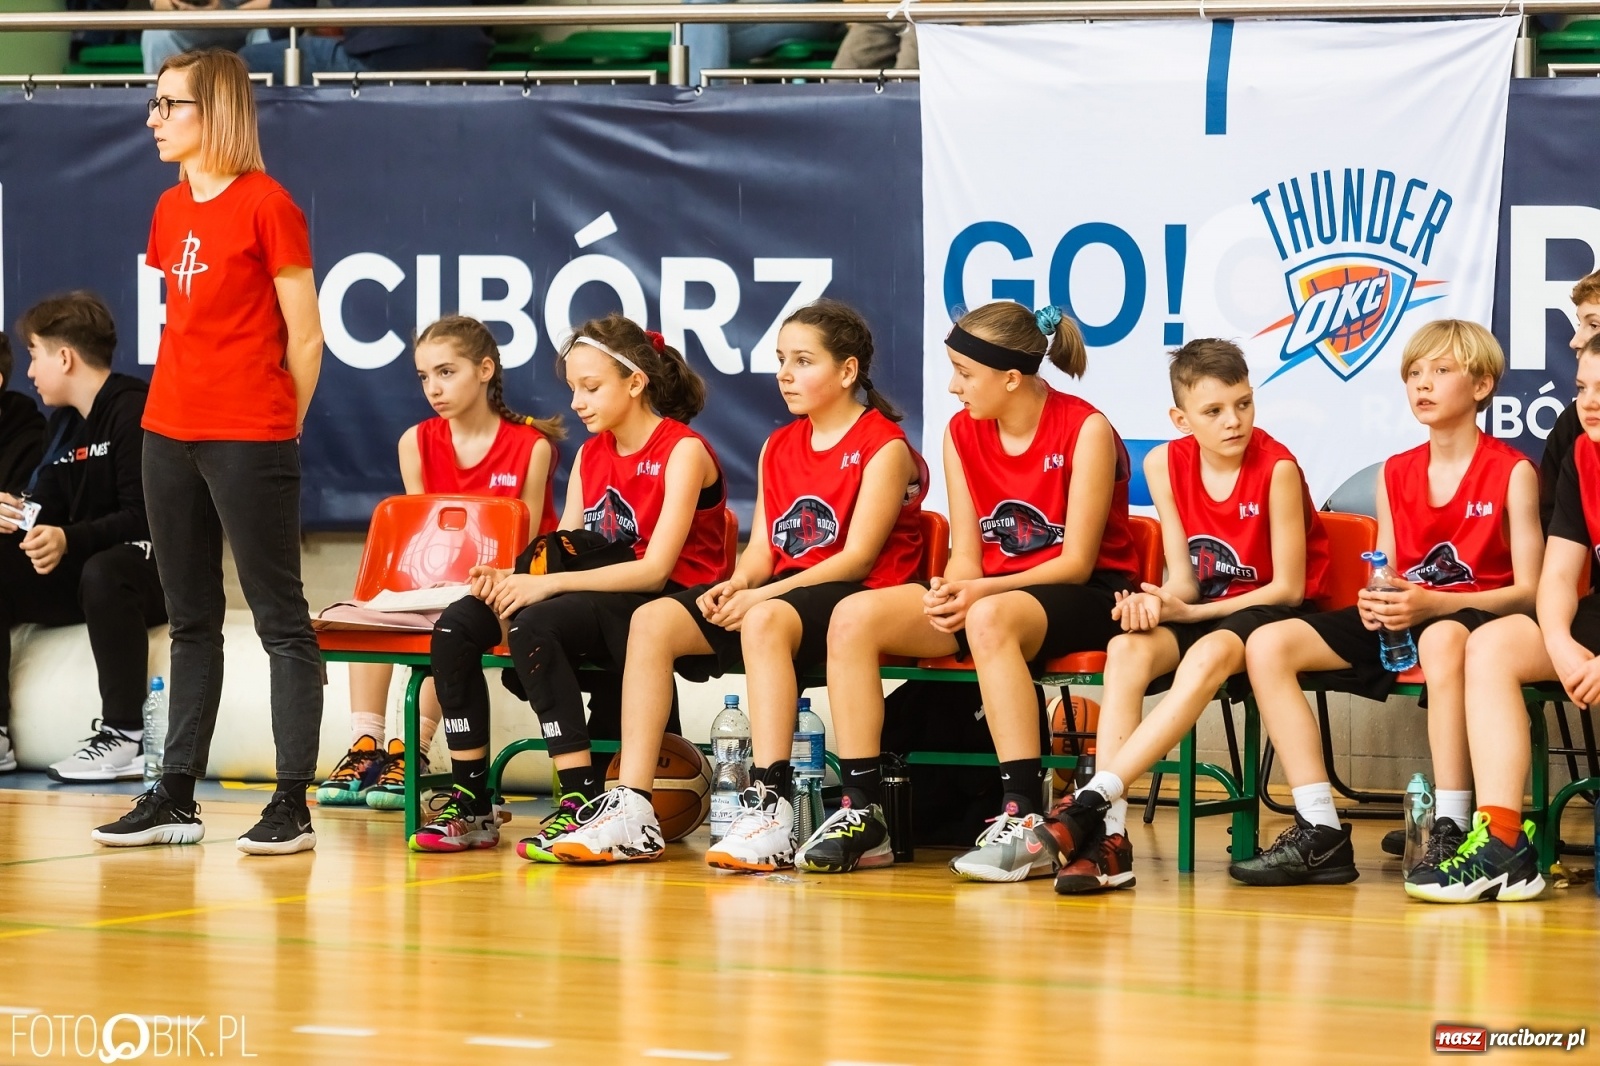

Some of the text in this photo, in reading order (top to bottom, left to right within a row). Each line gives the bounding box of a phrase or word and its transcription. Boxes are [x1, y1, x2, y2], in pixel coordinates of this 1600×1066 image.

[1251, 168, 1453, 266] THUNDER
[137, 211, 833, 375] CIBÓRZ
[943, 221, 1188, 347] GO!
[1286, 275, 1388, 355] OKC
[982, 516, 1016, 532] HOUSTON
[1215, 560, 1252, 577] ROCKETS
[450, 717, 471, 733] NBA
